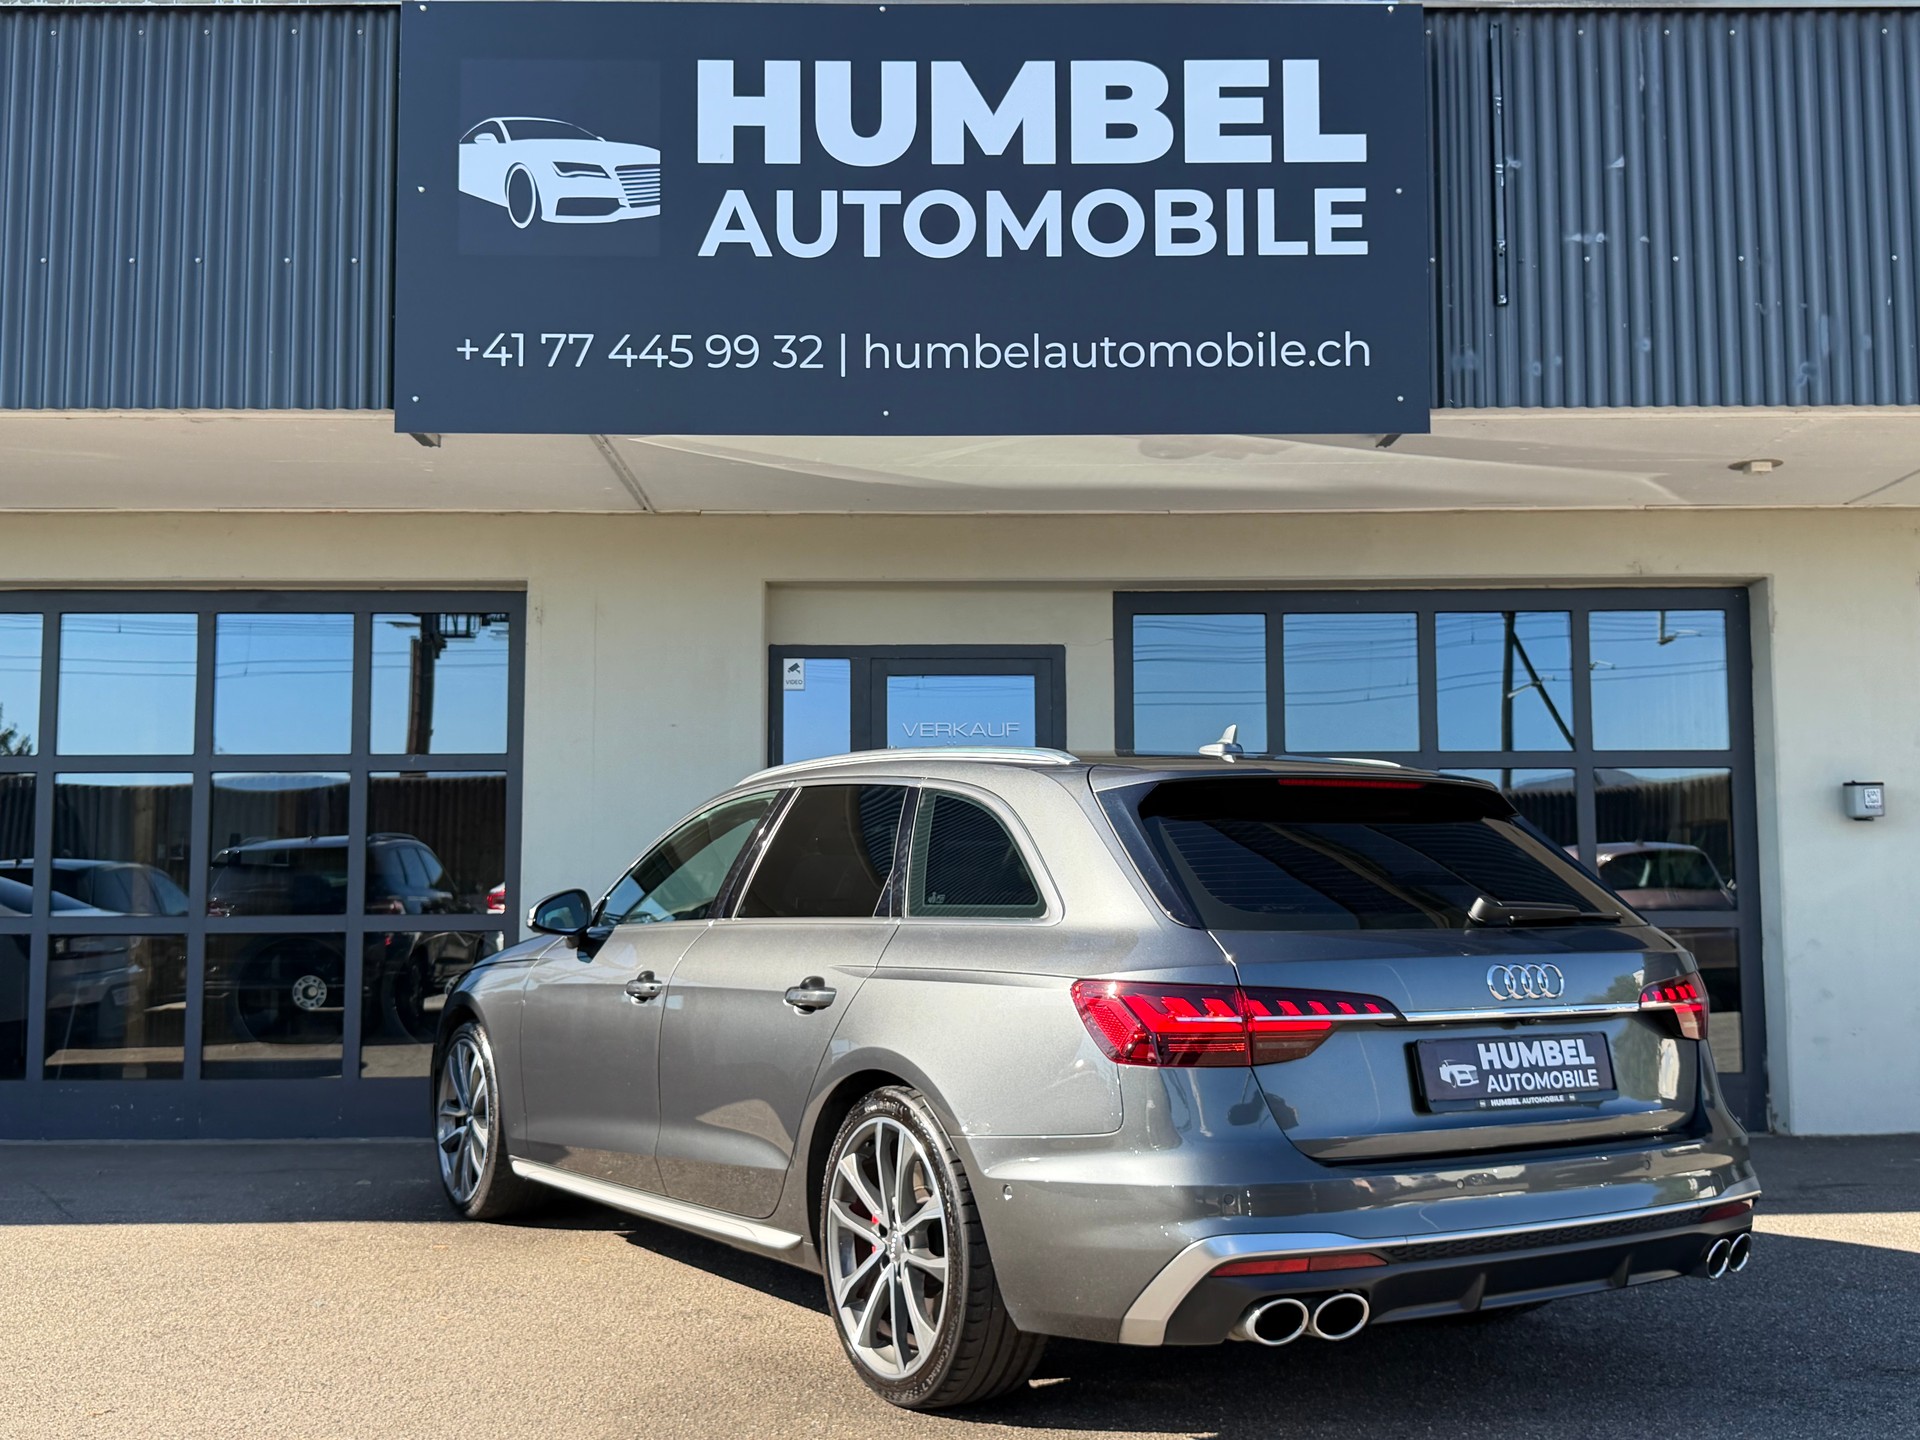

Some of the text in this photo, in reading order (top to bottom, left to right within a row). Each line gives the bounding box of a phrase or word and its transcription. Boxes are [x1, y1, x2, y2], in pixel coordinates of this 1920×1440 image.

[697, 59, 1367, 167] HUMBEL
[697, 187, 1369, 259] AUTOMOBILE
[456, 332, 524, 367] +41
[540, 333, 595, 368] 77
[607, 333, 694, 369] 445
[705, 334, 760, 369] 99
[772, 334, 824, 369] 32
[865, 330, 1370, 369] humbelautomobile.ch
[902, 722, 1020, 738] VERKAUF
[1477, 1038, 1596, 1070] HUMBEL
[1486, 1068, 1600, 1093] AUTOMOBILE
[1490, 1094, 1565, 1107] HUMBEL AUTOMOBILE
